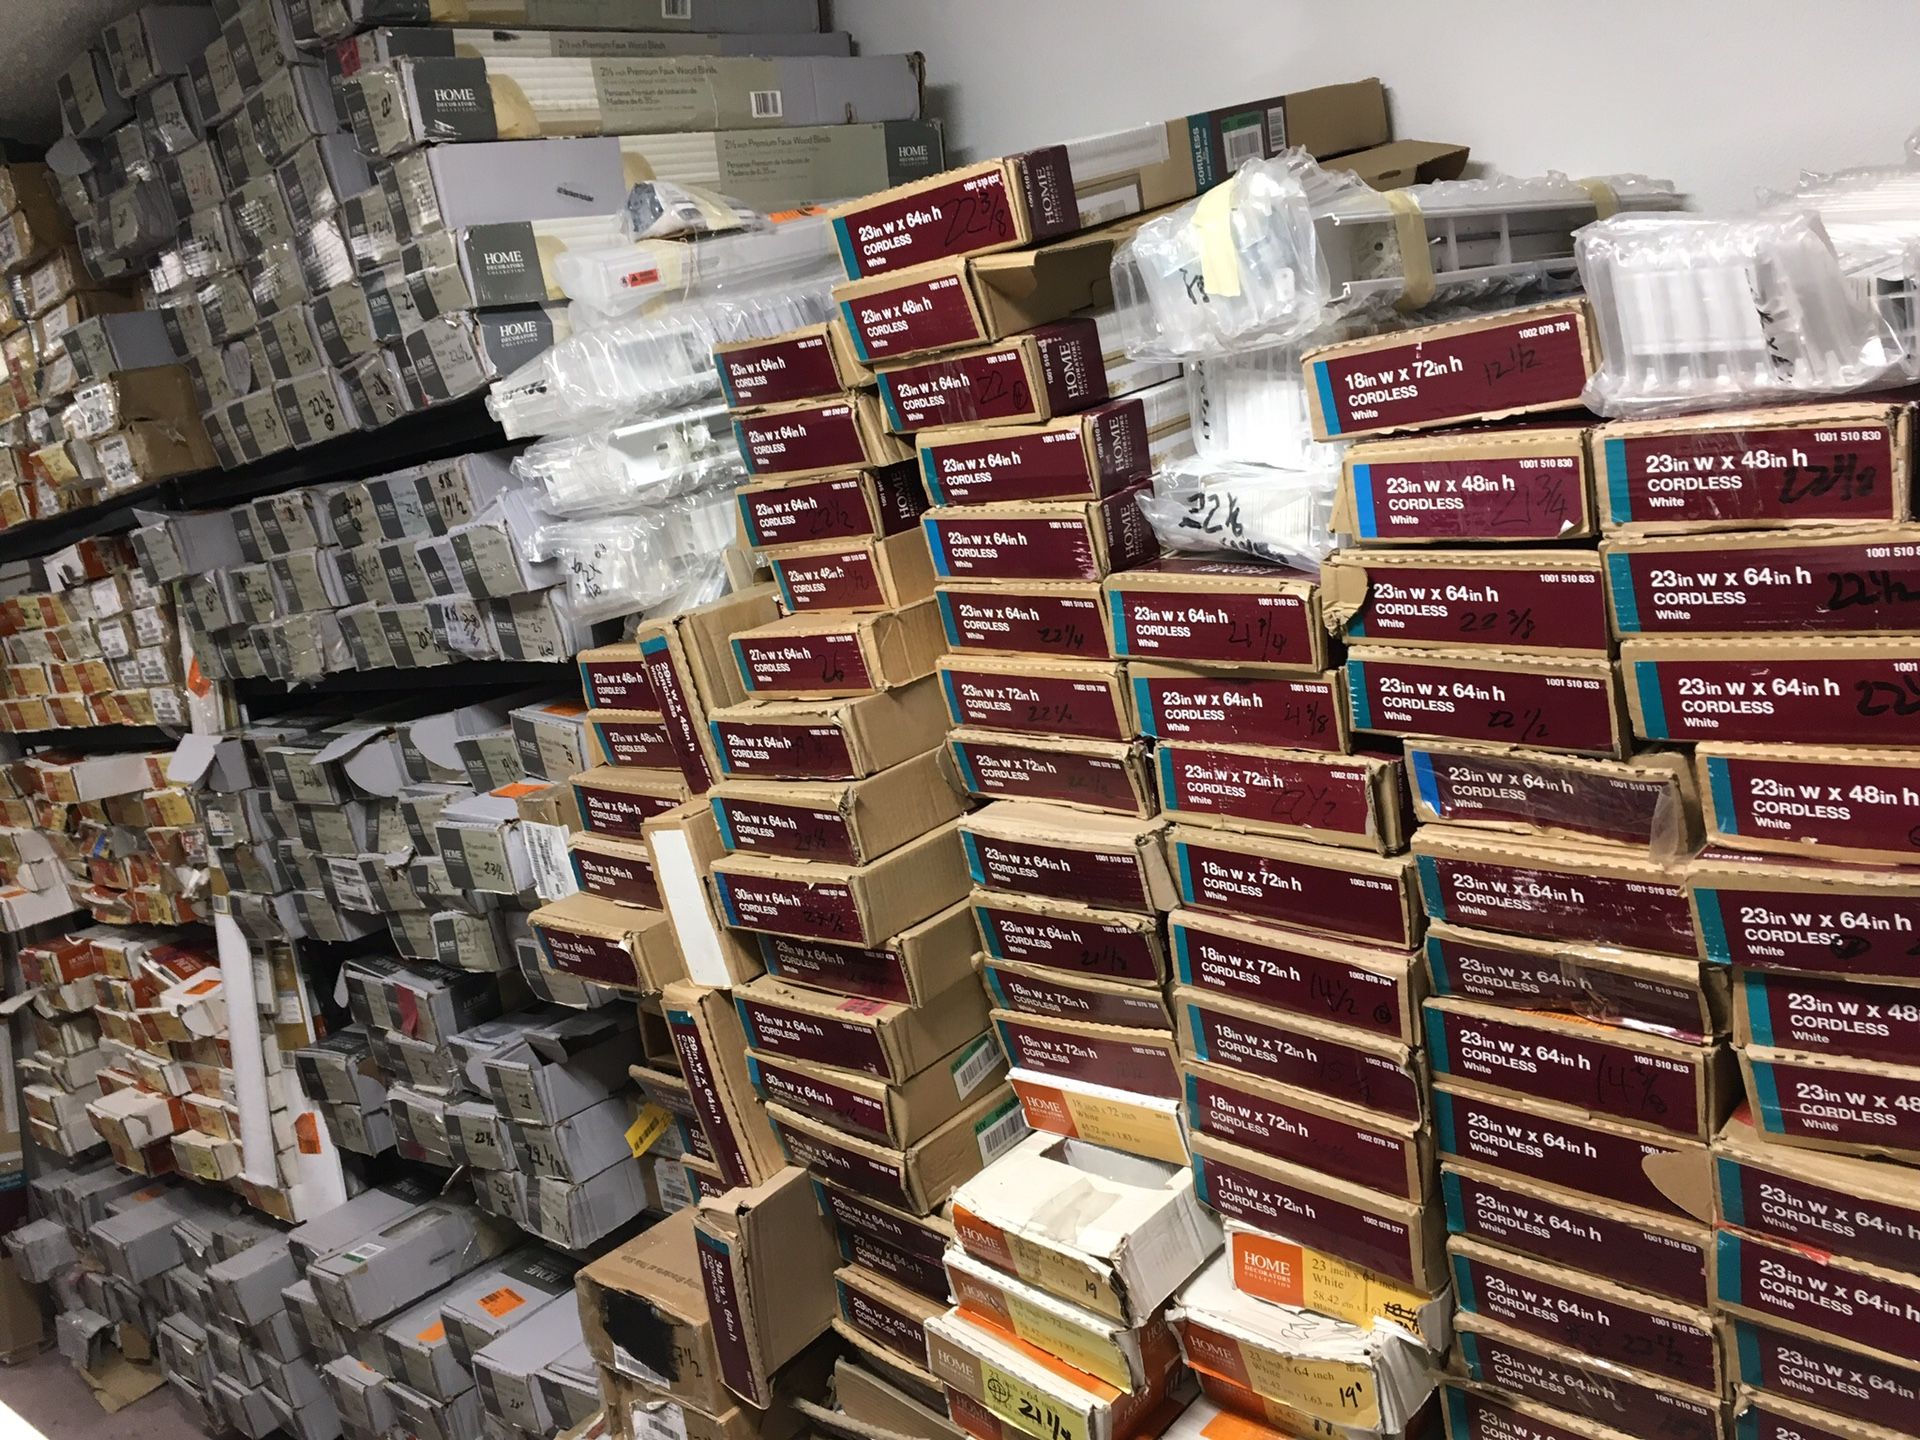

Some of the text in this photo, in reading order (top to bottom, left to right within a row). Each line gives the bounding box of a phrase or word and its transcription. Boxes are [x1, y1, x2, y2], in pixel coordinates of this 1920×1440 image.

[627, 66, 656, 77] Premium
[658, 66, 675, 75] Faux
[677, 66, 697, 75] Wood
[434, 88, 476, 101] HOME
[748, 134, 831, 148] Premium Faux Wood Blinds
[899, 145, 928, 157] HOME
[1038, 168, 1055, 225] HOME
[859, 206, 942, 242] 23in w x 64in h
[864, 234, 912, 256] CORDLESS
[484, 251, 522, 264] HOME
[867, 257, 886, 268] White
[500, 321, 537, 336] HOME
[867, 321, 909, 338] CORDLESS
[1518, 322, 1570, 339] 1002 078 784
[1063, 342, 1078, 399] HOME
[1345, 356, 1463, 390] 18in w x 72in h
[735, 376, 767, 388] CORDLESS
[1349, 385, 1418, 407] CORDLESS
[1351, 409, 1378, 421] White
[1814, 430, 1881, 442] 1001 510 830
[943, 451, 1021, 472] 23in w x 64in h
[1519, 459, 1573, 469] 1001 510 830
[1646, 449, 1808, 472] 23in w x 48in h
[946, 473, 992, 485] CORDLESS
[1386, 475, 1515, 494] 23in w x 48in h
[1648, 476, 1743, 491] CORDLESS
[1388, 499, 1464, 510] CORDLESS
[1649, 497, 1684, 507] White
[1390, 515, 1419, 525] White
[1540, 574, 1595, 583] 1001 510 833
[1650, 566, 1812, 588] 23in w x 64in h
[1374, 584, 1499, 602] 23in w x 64in h
[1654, 592, 1746, 604] CORDLESS
[1376, 604, 1448, 617] CORDLESS
[1656, 610, 1691, 620] White
[1136, 625, 1191, 637] CORDLESS
[1377, 619, 1405, 628] White
[750, 647, 811, 660] 27in w x 64in h
[754, 664, 790, 672] CORDLESS
[595, 672, 636, 684] 27in 48in
[597, 686, 626, 694] CORDLESS
[1678, 678, 1840, 696] 23in w x 64in h
[1382, 697, 1455, 712] CORDLESS
[1682, 701, 1774, 714] CORDLESS
[737, 825, 774, 837] CORDLESS
[443, 849, 463, 859] HOME
[1201, 861, 1302, 891] 18in w x 72in h
[1203, 878, 1262, 897] CORDLESS
[1204, 890, 1228, 902] White
[759, 1025, 800, 1041] CORDLESS
[1460, 1030, 1591, 1070] 23in w x 64in h
[1462, 1047, 1537, 1073] CORDLESS
[1463, 1060, 1492, 1075] White
[1026, 1096, 1061, 1115] HOME
[1217, 1175, 1316, 1218] 11in w x 72in h
[1218, 1190, 1278, 1217] CORDLESS
[1220, 1201, 1243, 1214] White
[1760, 1183, 1902, 1237] 23in w x 64in
[1761, 1202, 1856, 1237] CORDLESS
[962, 1226, 999, 1249] HOME
[1244, 1251, 1291, 1276] HOME
[1244, 1264, 1291, 1283] DECORATORS
[1312, 1259, 1326, 1271] 23
[1330, 1265, 1352, 1277] inch
[1379, 1278, 1399, 1292] inch
[1312, 1274, 1344, 1289] White
[1313, 1290, 1340, 1306] 58.42
[1191, 1335, 1234, 1362] HOME
[938, 1349, 974, 1378] HOME
[1294, 1363, 1335, 1381] 64 inch
